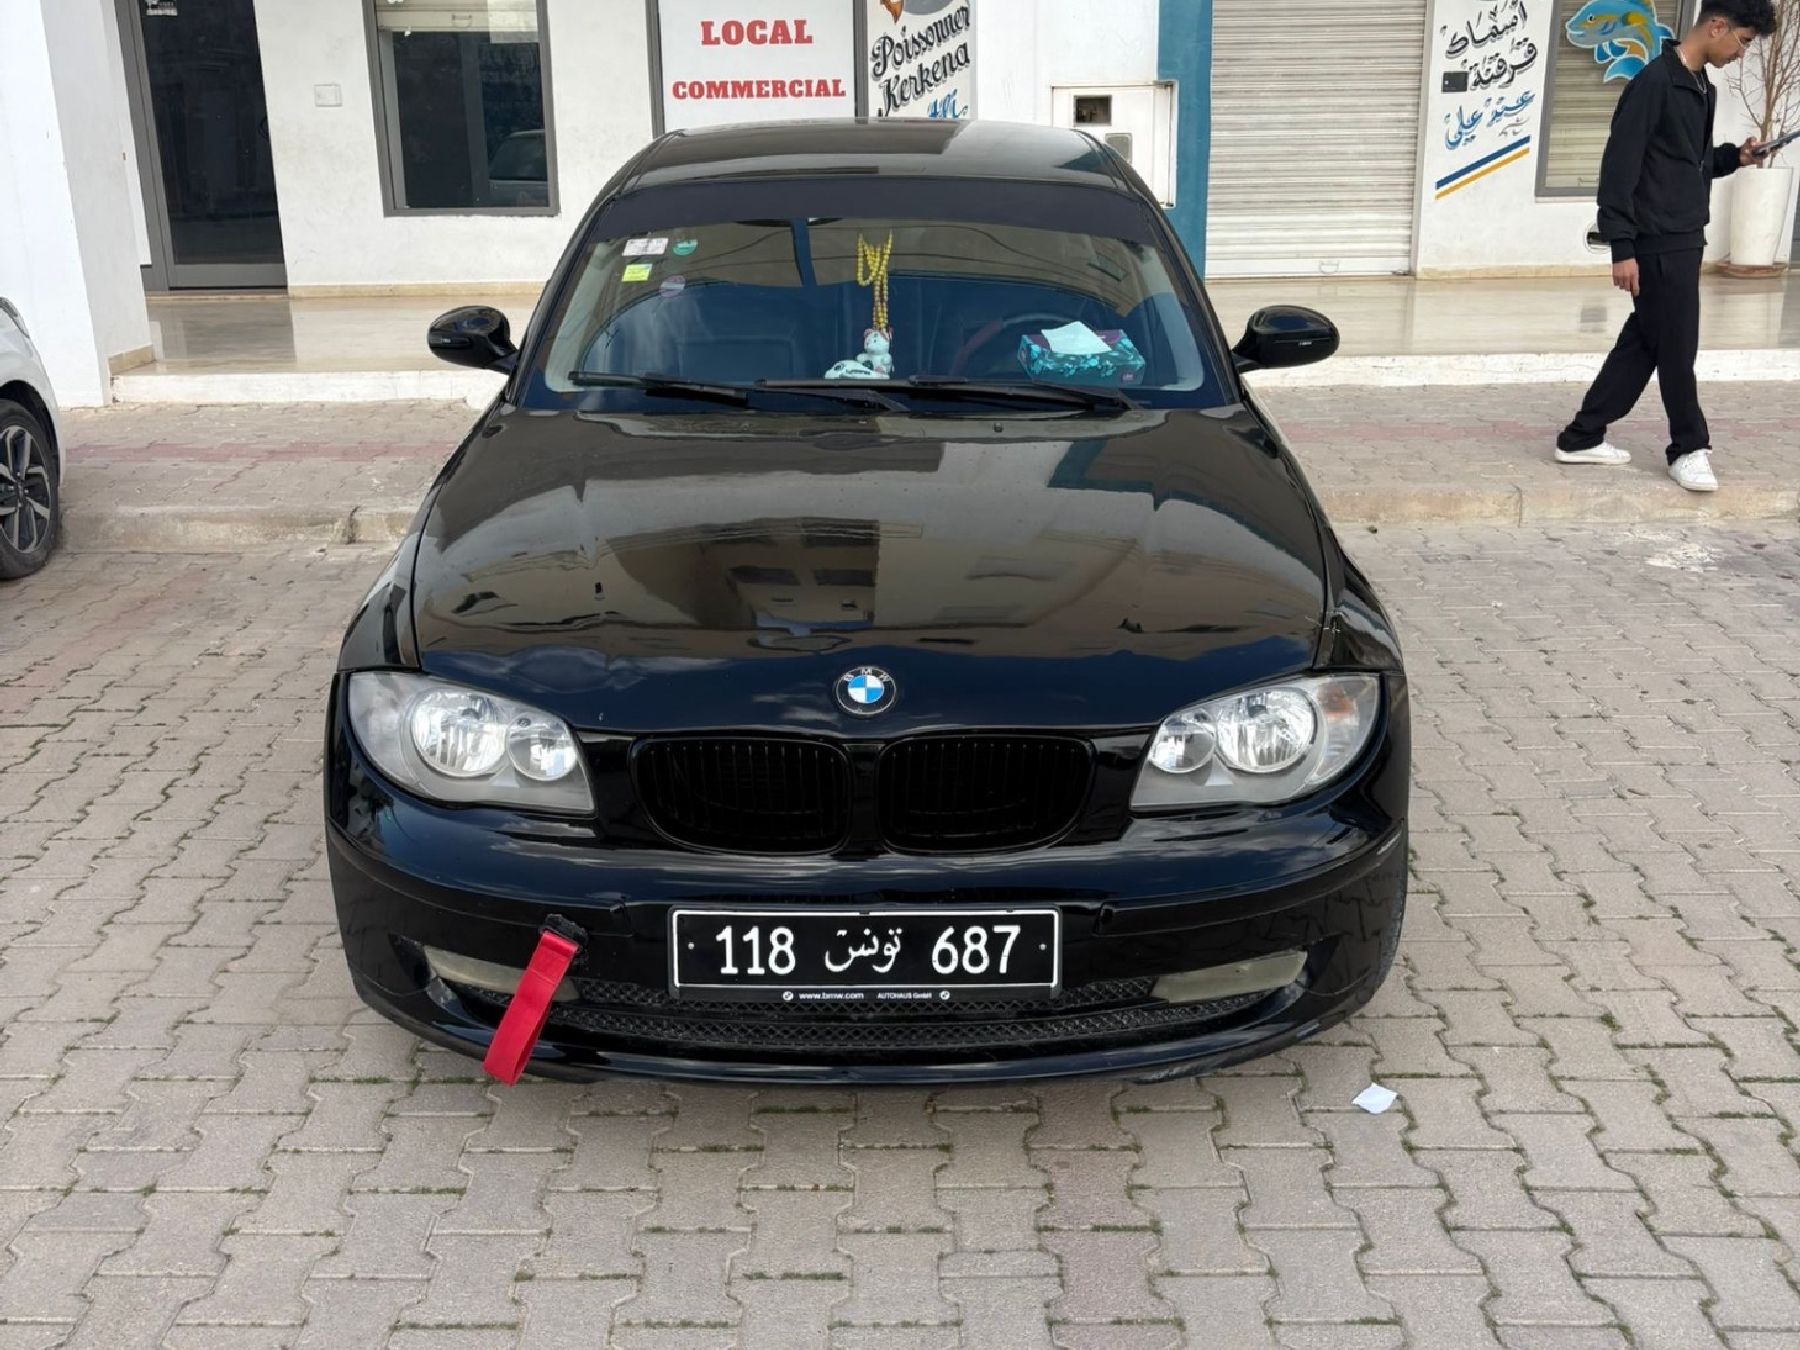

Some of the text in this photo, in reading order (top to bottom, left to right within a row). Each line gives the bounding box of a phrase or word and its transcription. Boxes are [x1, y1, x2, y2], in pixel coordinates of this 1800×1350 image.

[701, 19, 812, 45] LOCAL
[672, 78, 846, 99] COMMERCIAL
[715, 925, 1021, 975] 118 تونس 687
[799, 991, 864, 1000] www.bmw.com
